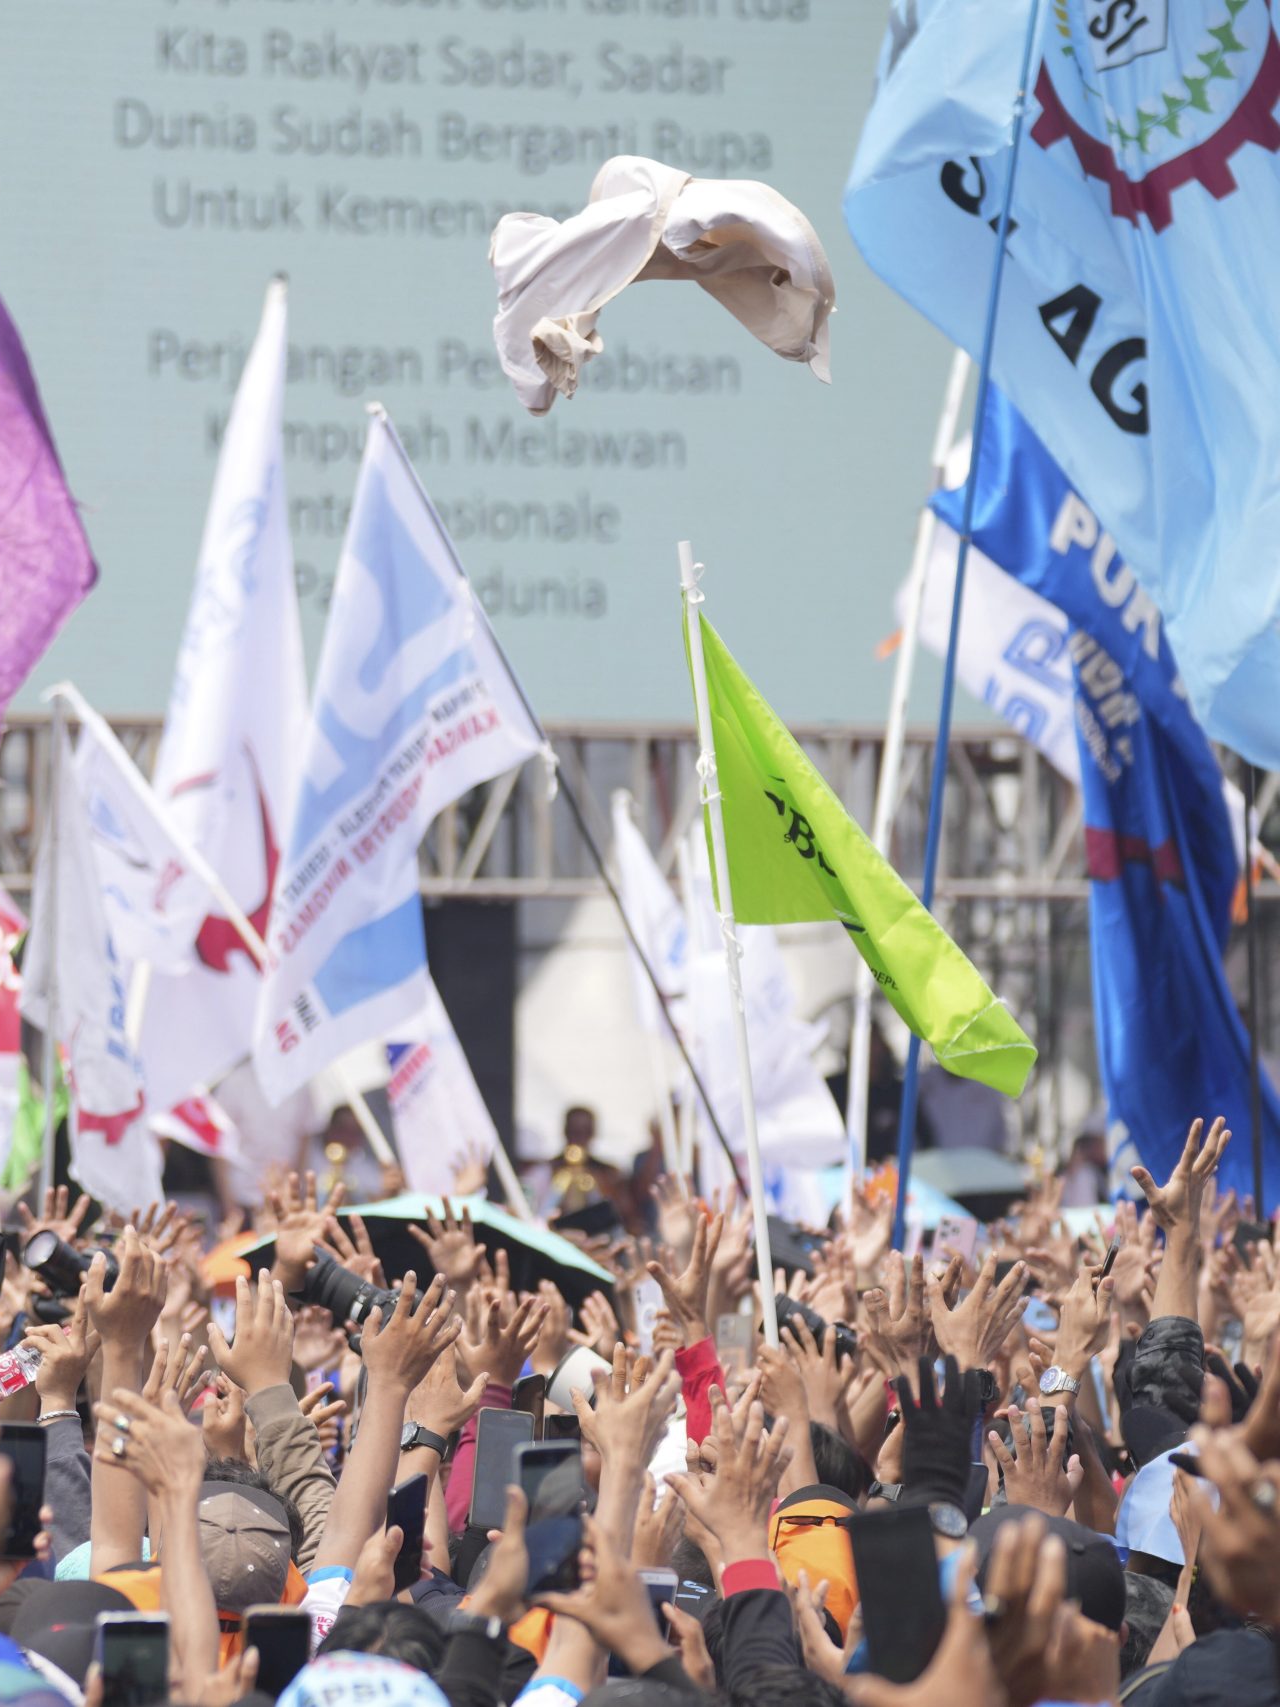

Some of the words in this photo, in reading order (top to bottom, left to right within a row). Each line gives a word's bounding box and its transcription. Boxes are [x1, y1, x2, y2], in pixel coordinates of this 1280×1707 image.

[156, 25, 248, 77] Kita
[262, 27, 423, 95] Rakyat
[438, 34, 581, 98] Sadar,
[597, 39, 732, 95] Sadar
[115, 98, 257, 152] Dunia
[271, 103, 421, 156] Sudah
[437, 110, 638, 175] Berganti
[652, 118, 773, 177] Rupa
[152, 176, 307, 231] Untuk
[467, 415, 687, 469] Melawan
[477, 569, 607, 620] dunia
